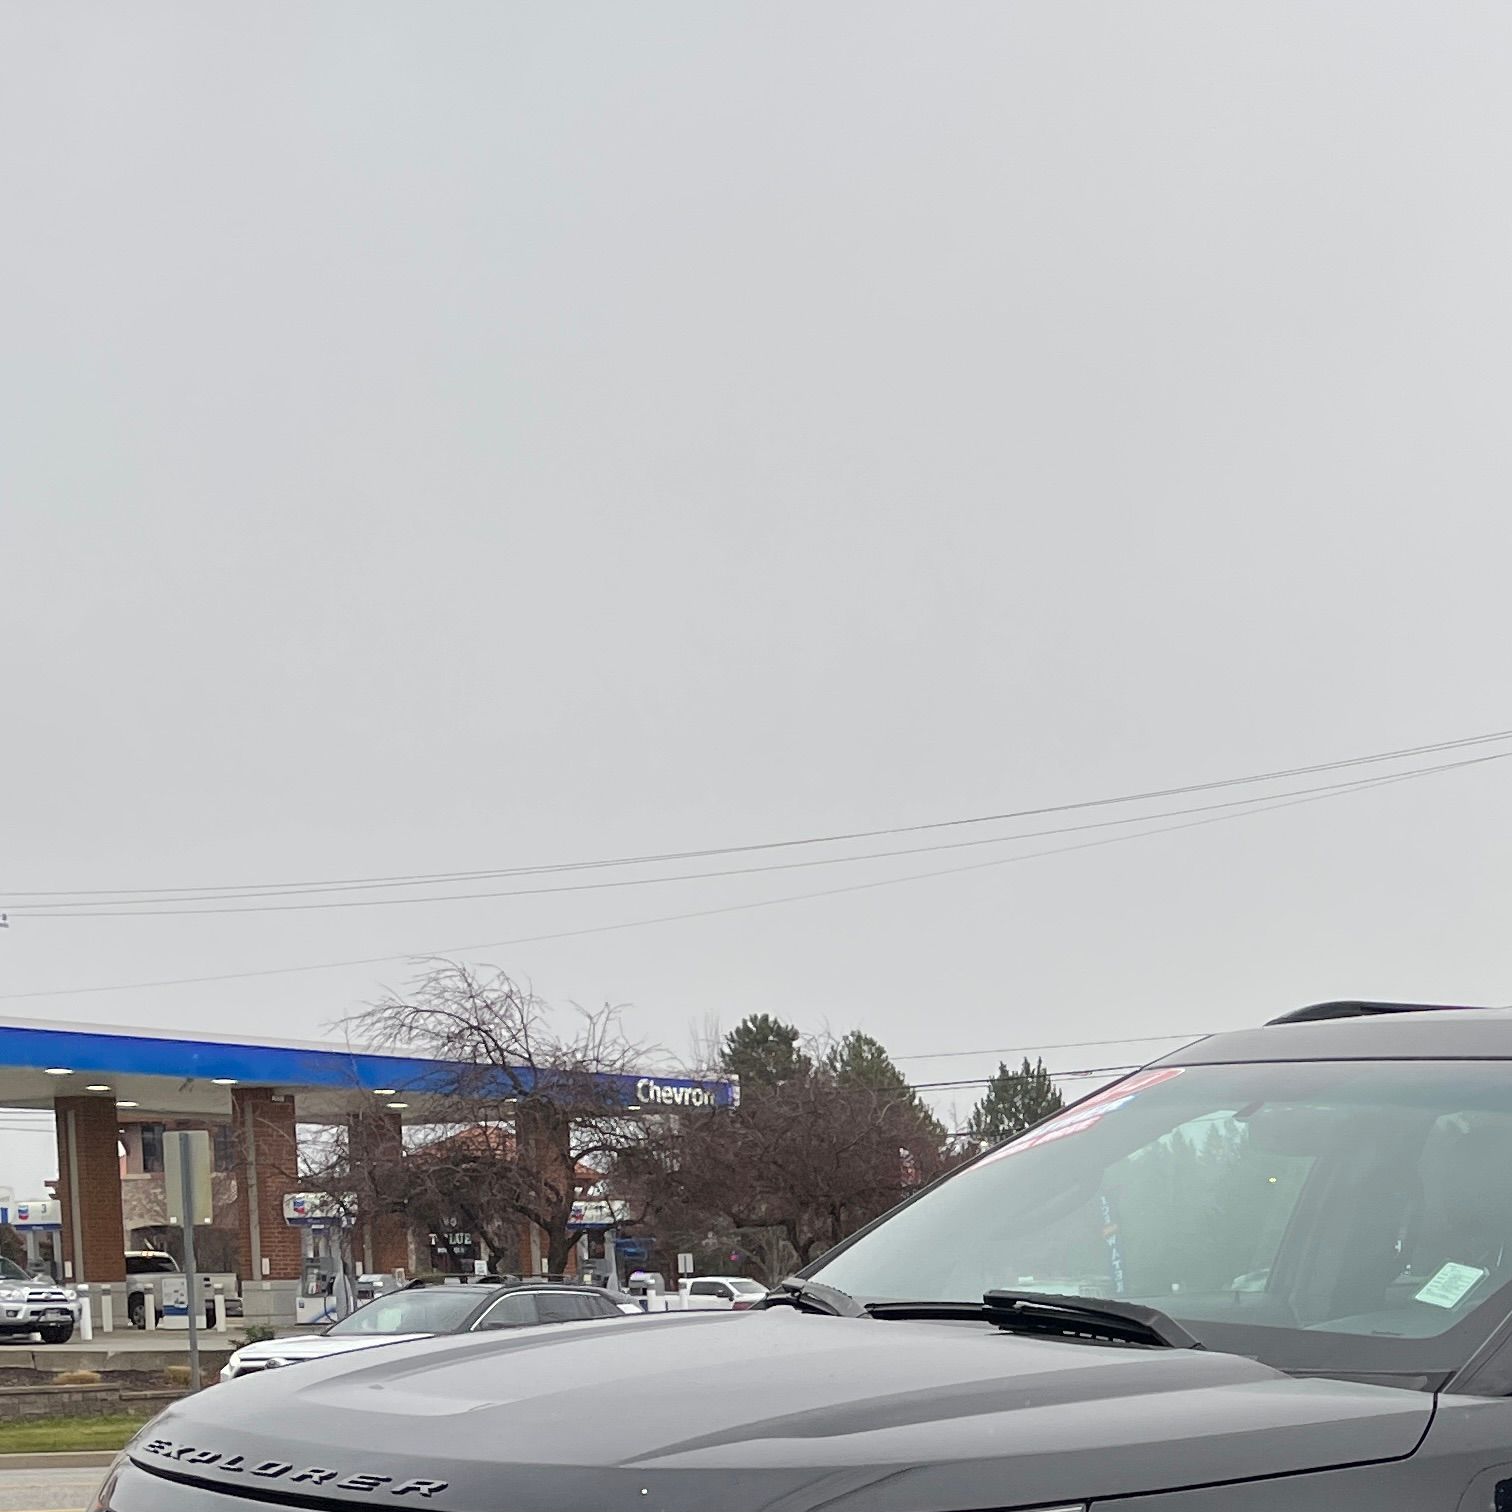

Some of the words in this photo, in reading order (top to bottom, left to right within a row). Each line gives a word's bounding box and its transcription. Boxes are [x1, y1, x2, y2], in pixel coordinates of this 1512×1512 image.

[637, 1078, 715, 1107] Chevron
[41, 1203, 47, 1214] 3
[143, 1439, 450, 1498] EXPLORER
